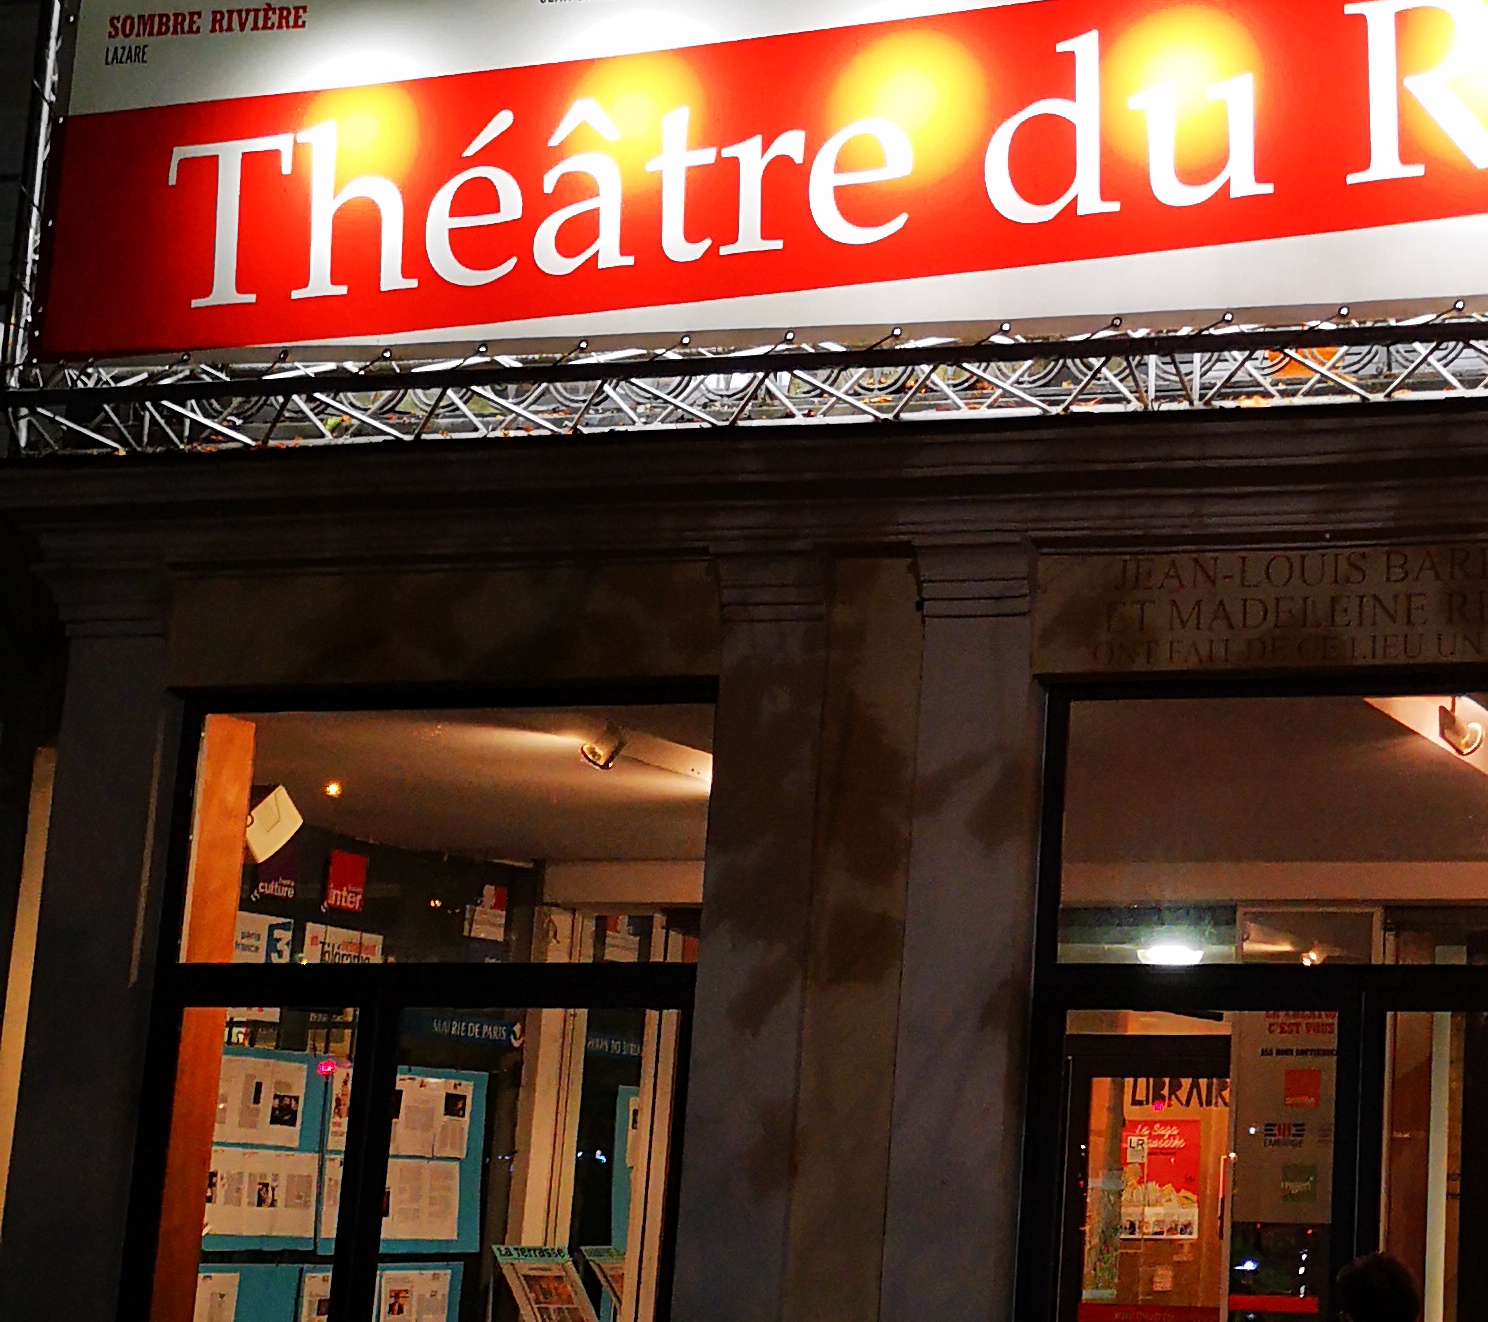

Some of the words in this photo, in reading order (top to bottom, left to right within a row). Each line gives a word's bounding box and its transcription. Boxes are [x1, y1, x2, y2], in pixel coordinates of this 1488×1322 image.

[108, 11, 202, 39] SOMBRE
[209, 3, 307, 33] RIVIÈRE
[105, 45, 148, 66] LAZARE
[168, 98, 912, 308] Théâtre
[984, 30, 1274, 225] du
[1114, 551, 1370, 592] JEAN-LOUIS
[1168, 592, 1428, 633] MADELEINE
